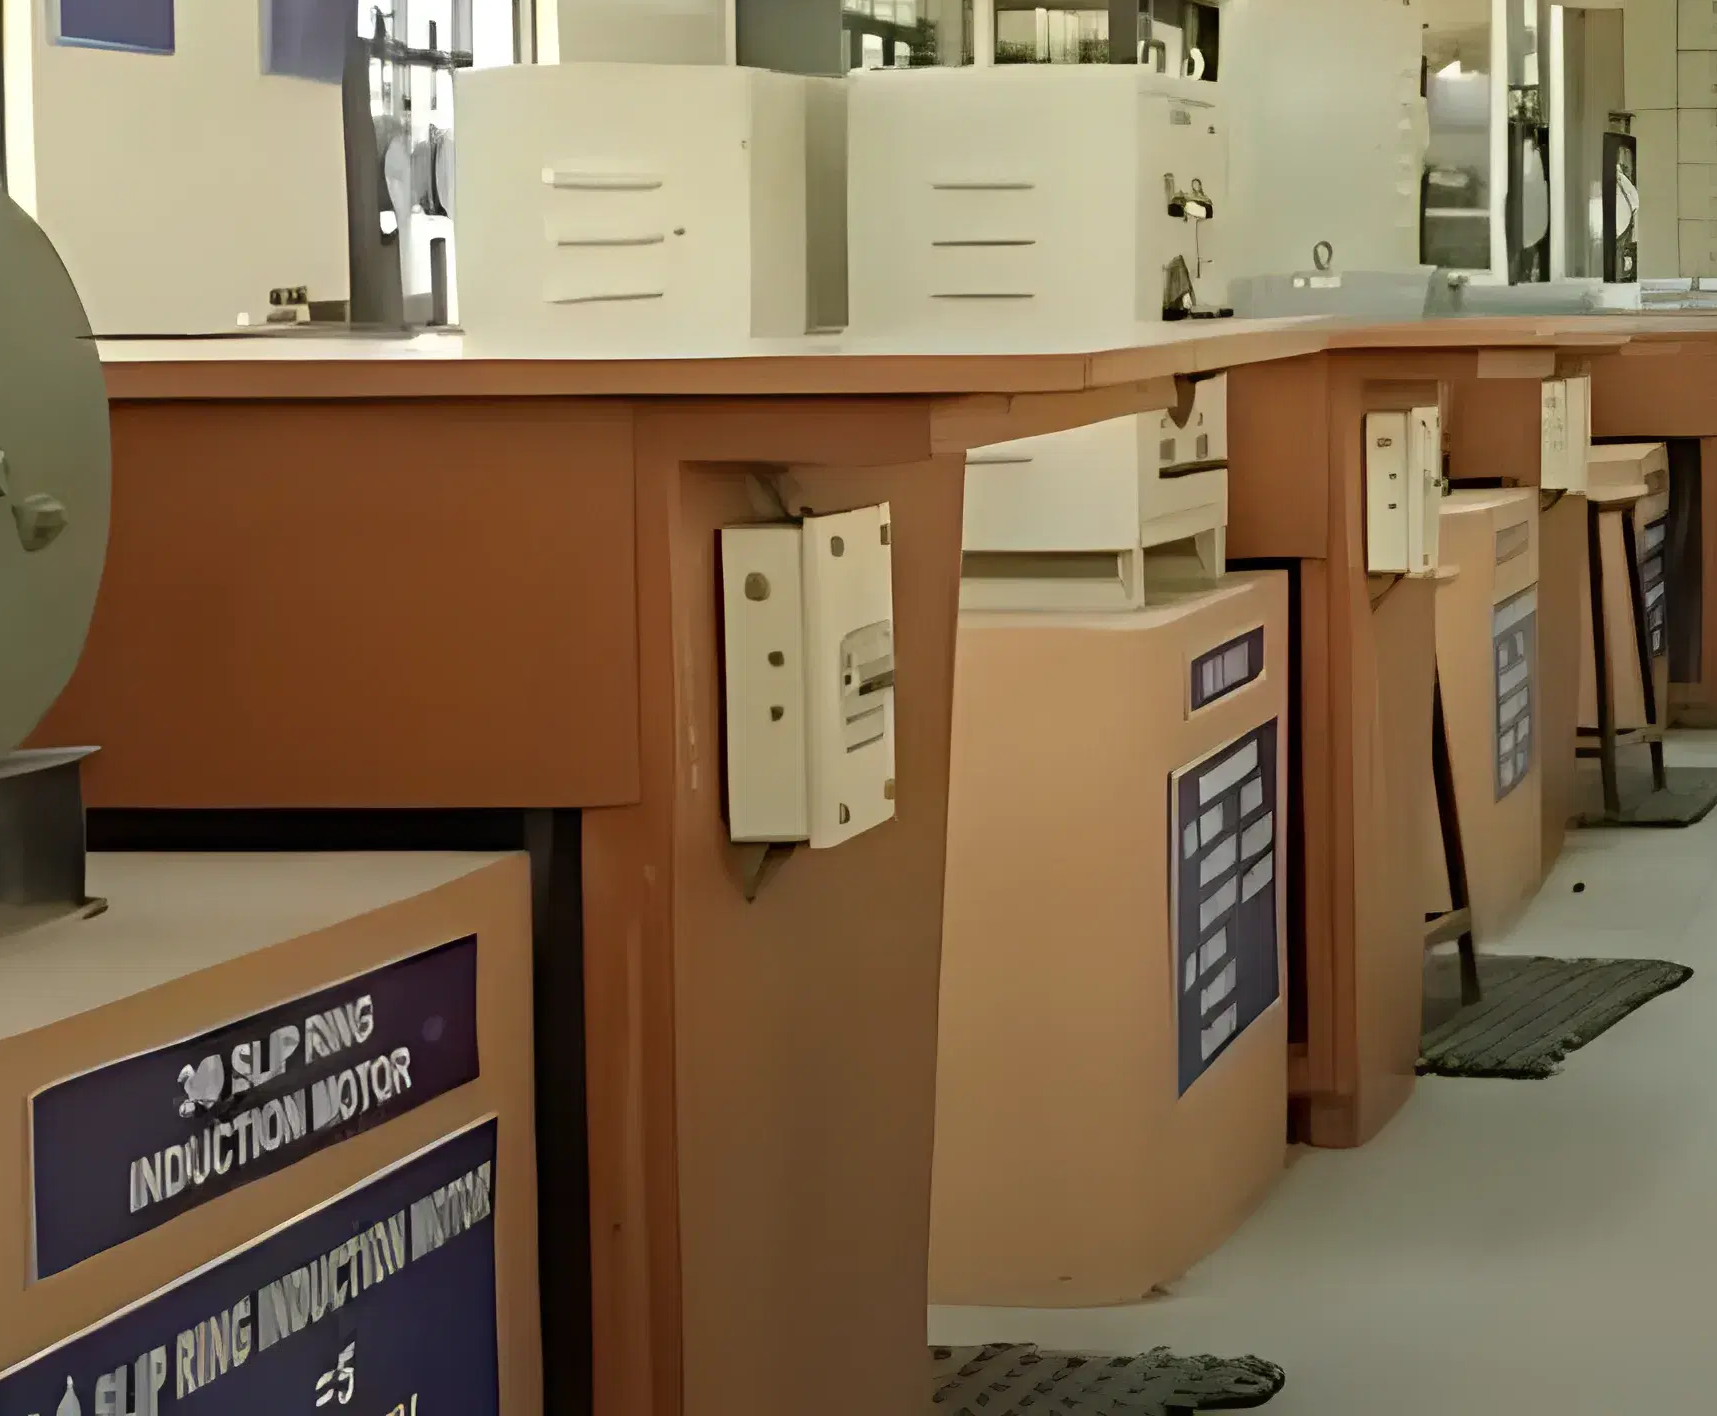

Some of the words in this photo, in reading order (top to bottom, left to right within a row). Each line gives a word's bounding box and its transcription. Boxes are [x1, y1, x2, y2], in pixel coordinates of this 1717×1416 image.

[305, 995, 374, 1064] RING
[130, 1090, 307, 1213] INDUCTION
[312, 1046, 412, 1131] MOTOR
[177, 1295, 251, 1399] RING
[258, 1209, 405, 1352] INDUCTION
